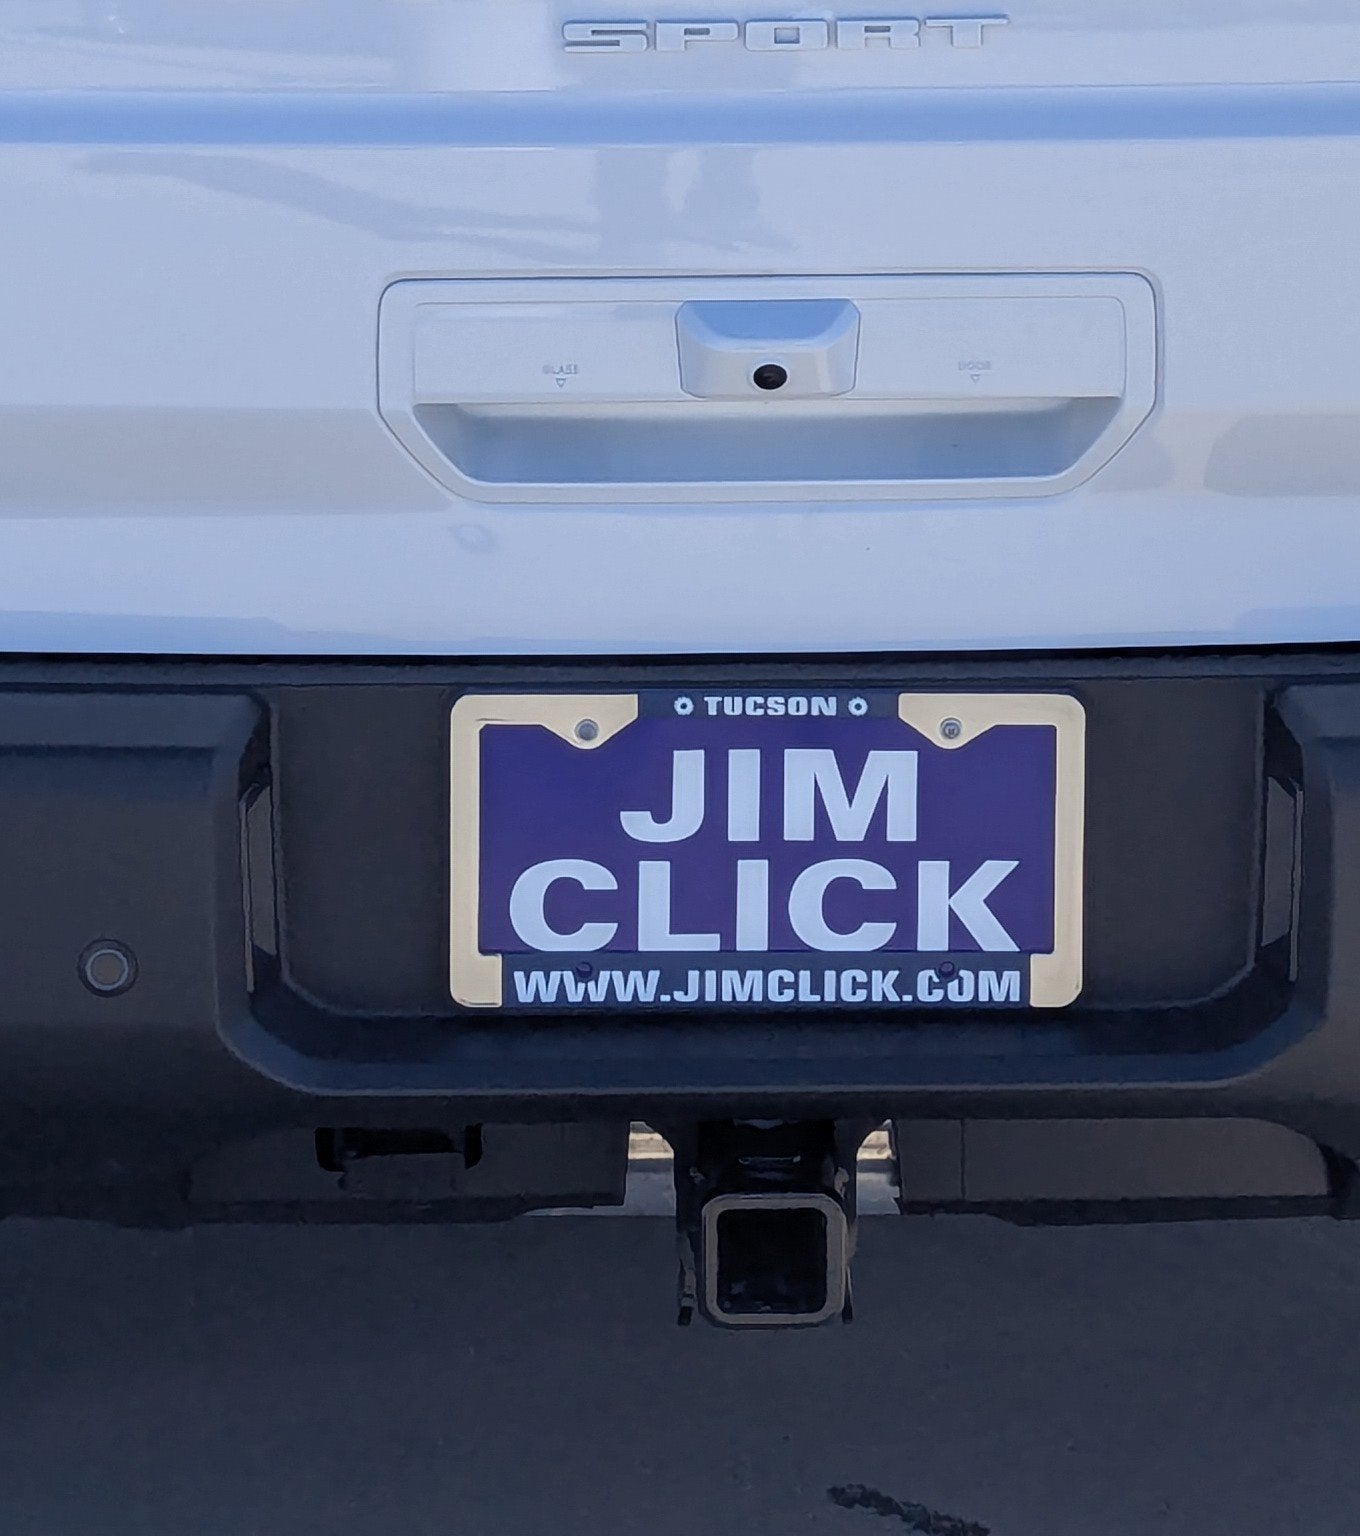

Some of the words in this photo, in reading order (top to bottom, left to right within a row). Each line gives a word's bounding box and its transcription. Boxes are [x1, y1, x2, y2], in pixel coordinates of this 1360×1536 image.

[562, 13, 1009, 52] SPORT
[703, 695, 837, 717] TUCSON
[619, 747, 919, 843] JIM
[508, 858, 1021, 952] CLICK
[513, 968, 1021, 1004] WWW.JIMCLICK.COM
